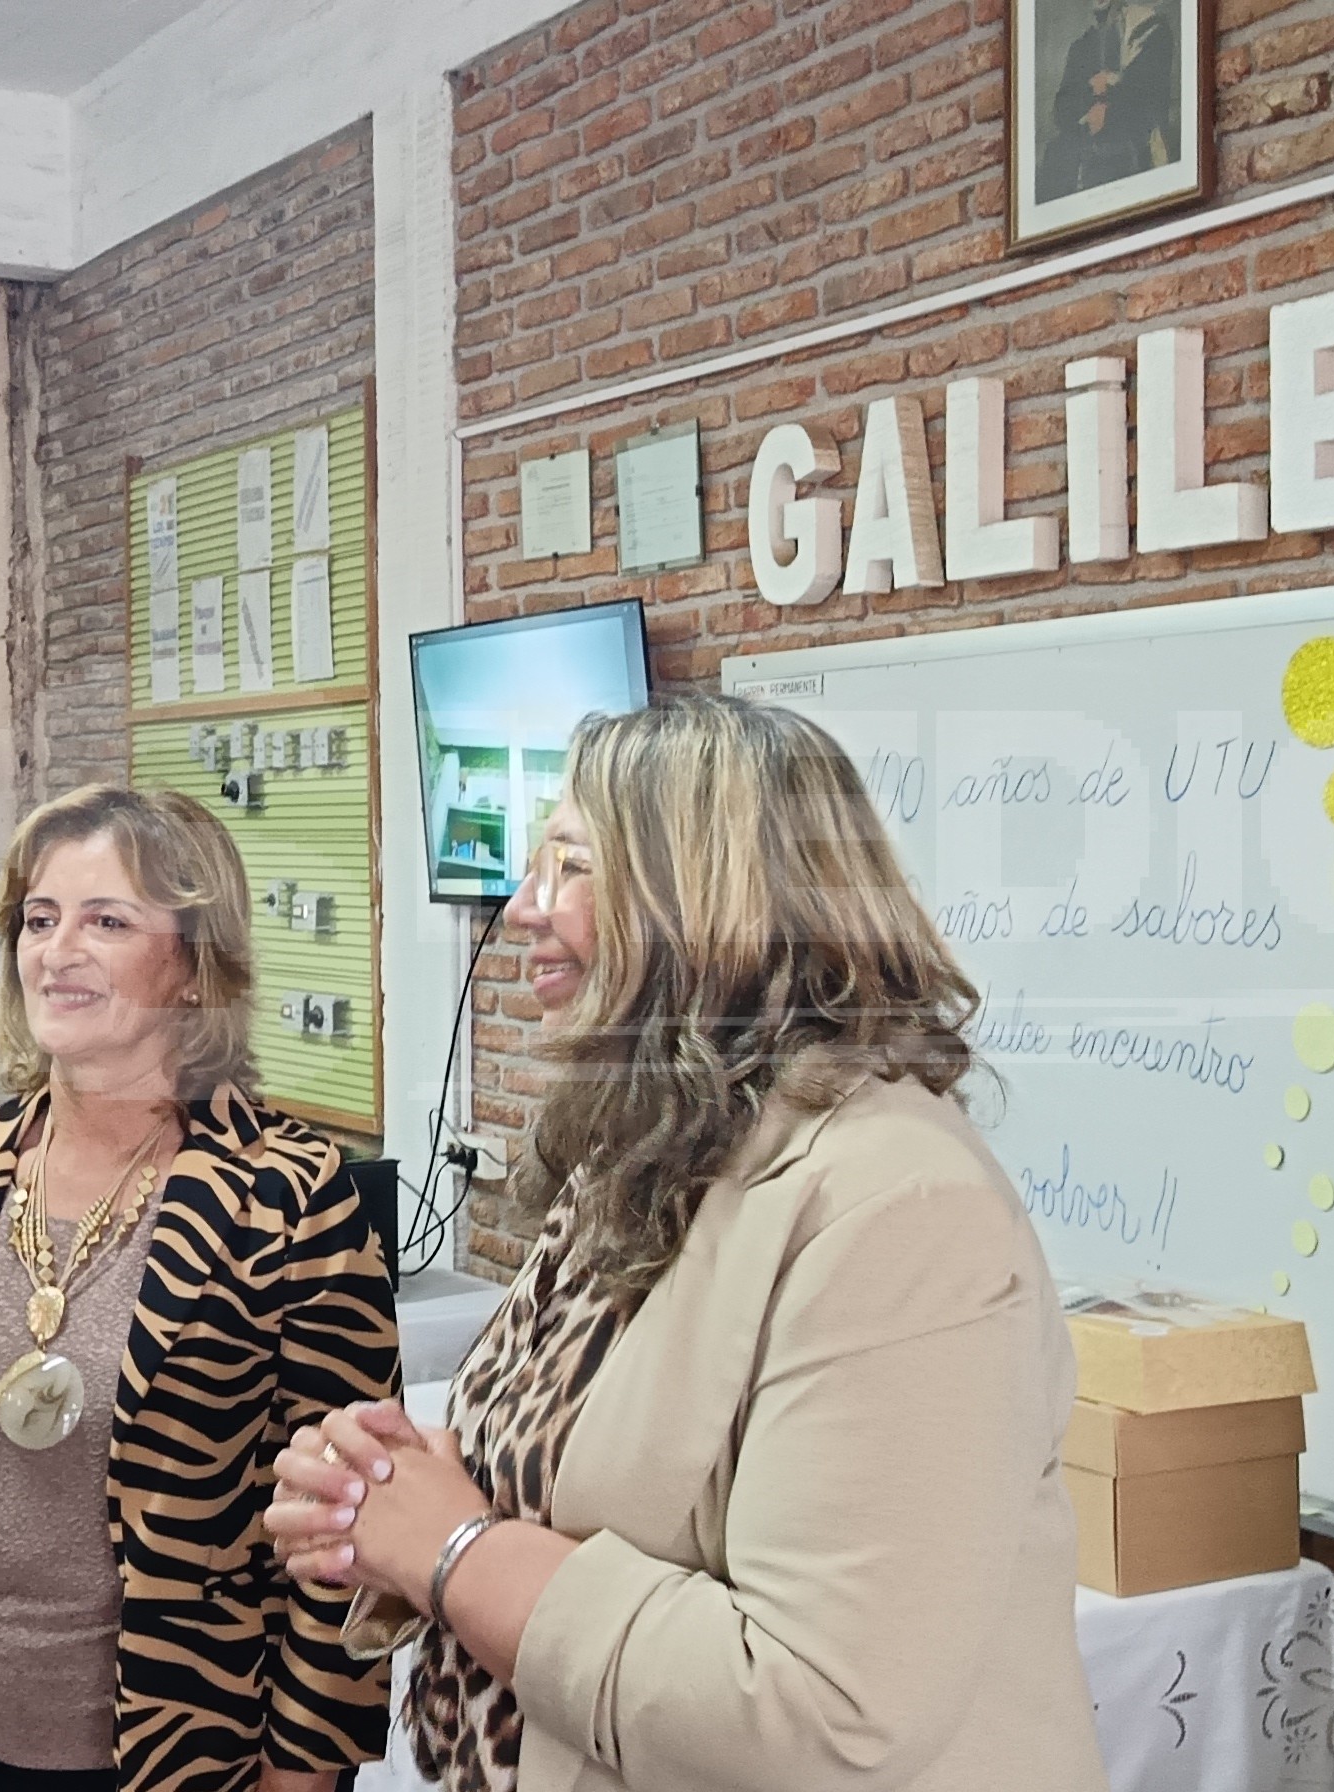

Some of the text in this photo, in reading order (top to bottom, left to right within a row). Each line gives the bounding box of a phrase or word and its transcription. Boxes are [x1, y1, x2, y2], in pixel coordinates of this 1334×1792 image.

[769, 679, 817, 697] PERMANENTE
[942, 756, 1051, 810] años
[1068, 739, 1130, 806] de
[1165, 737, 1276, 802] UTU
[1038, 874, 1089, 938] de
[1110, 850, 1282, 950] sabores
[1067, 1008, 1255, 1094] encuentro
